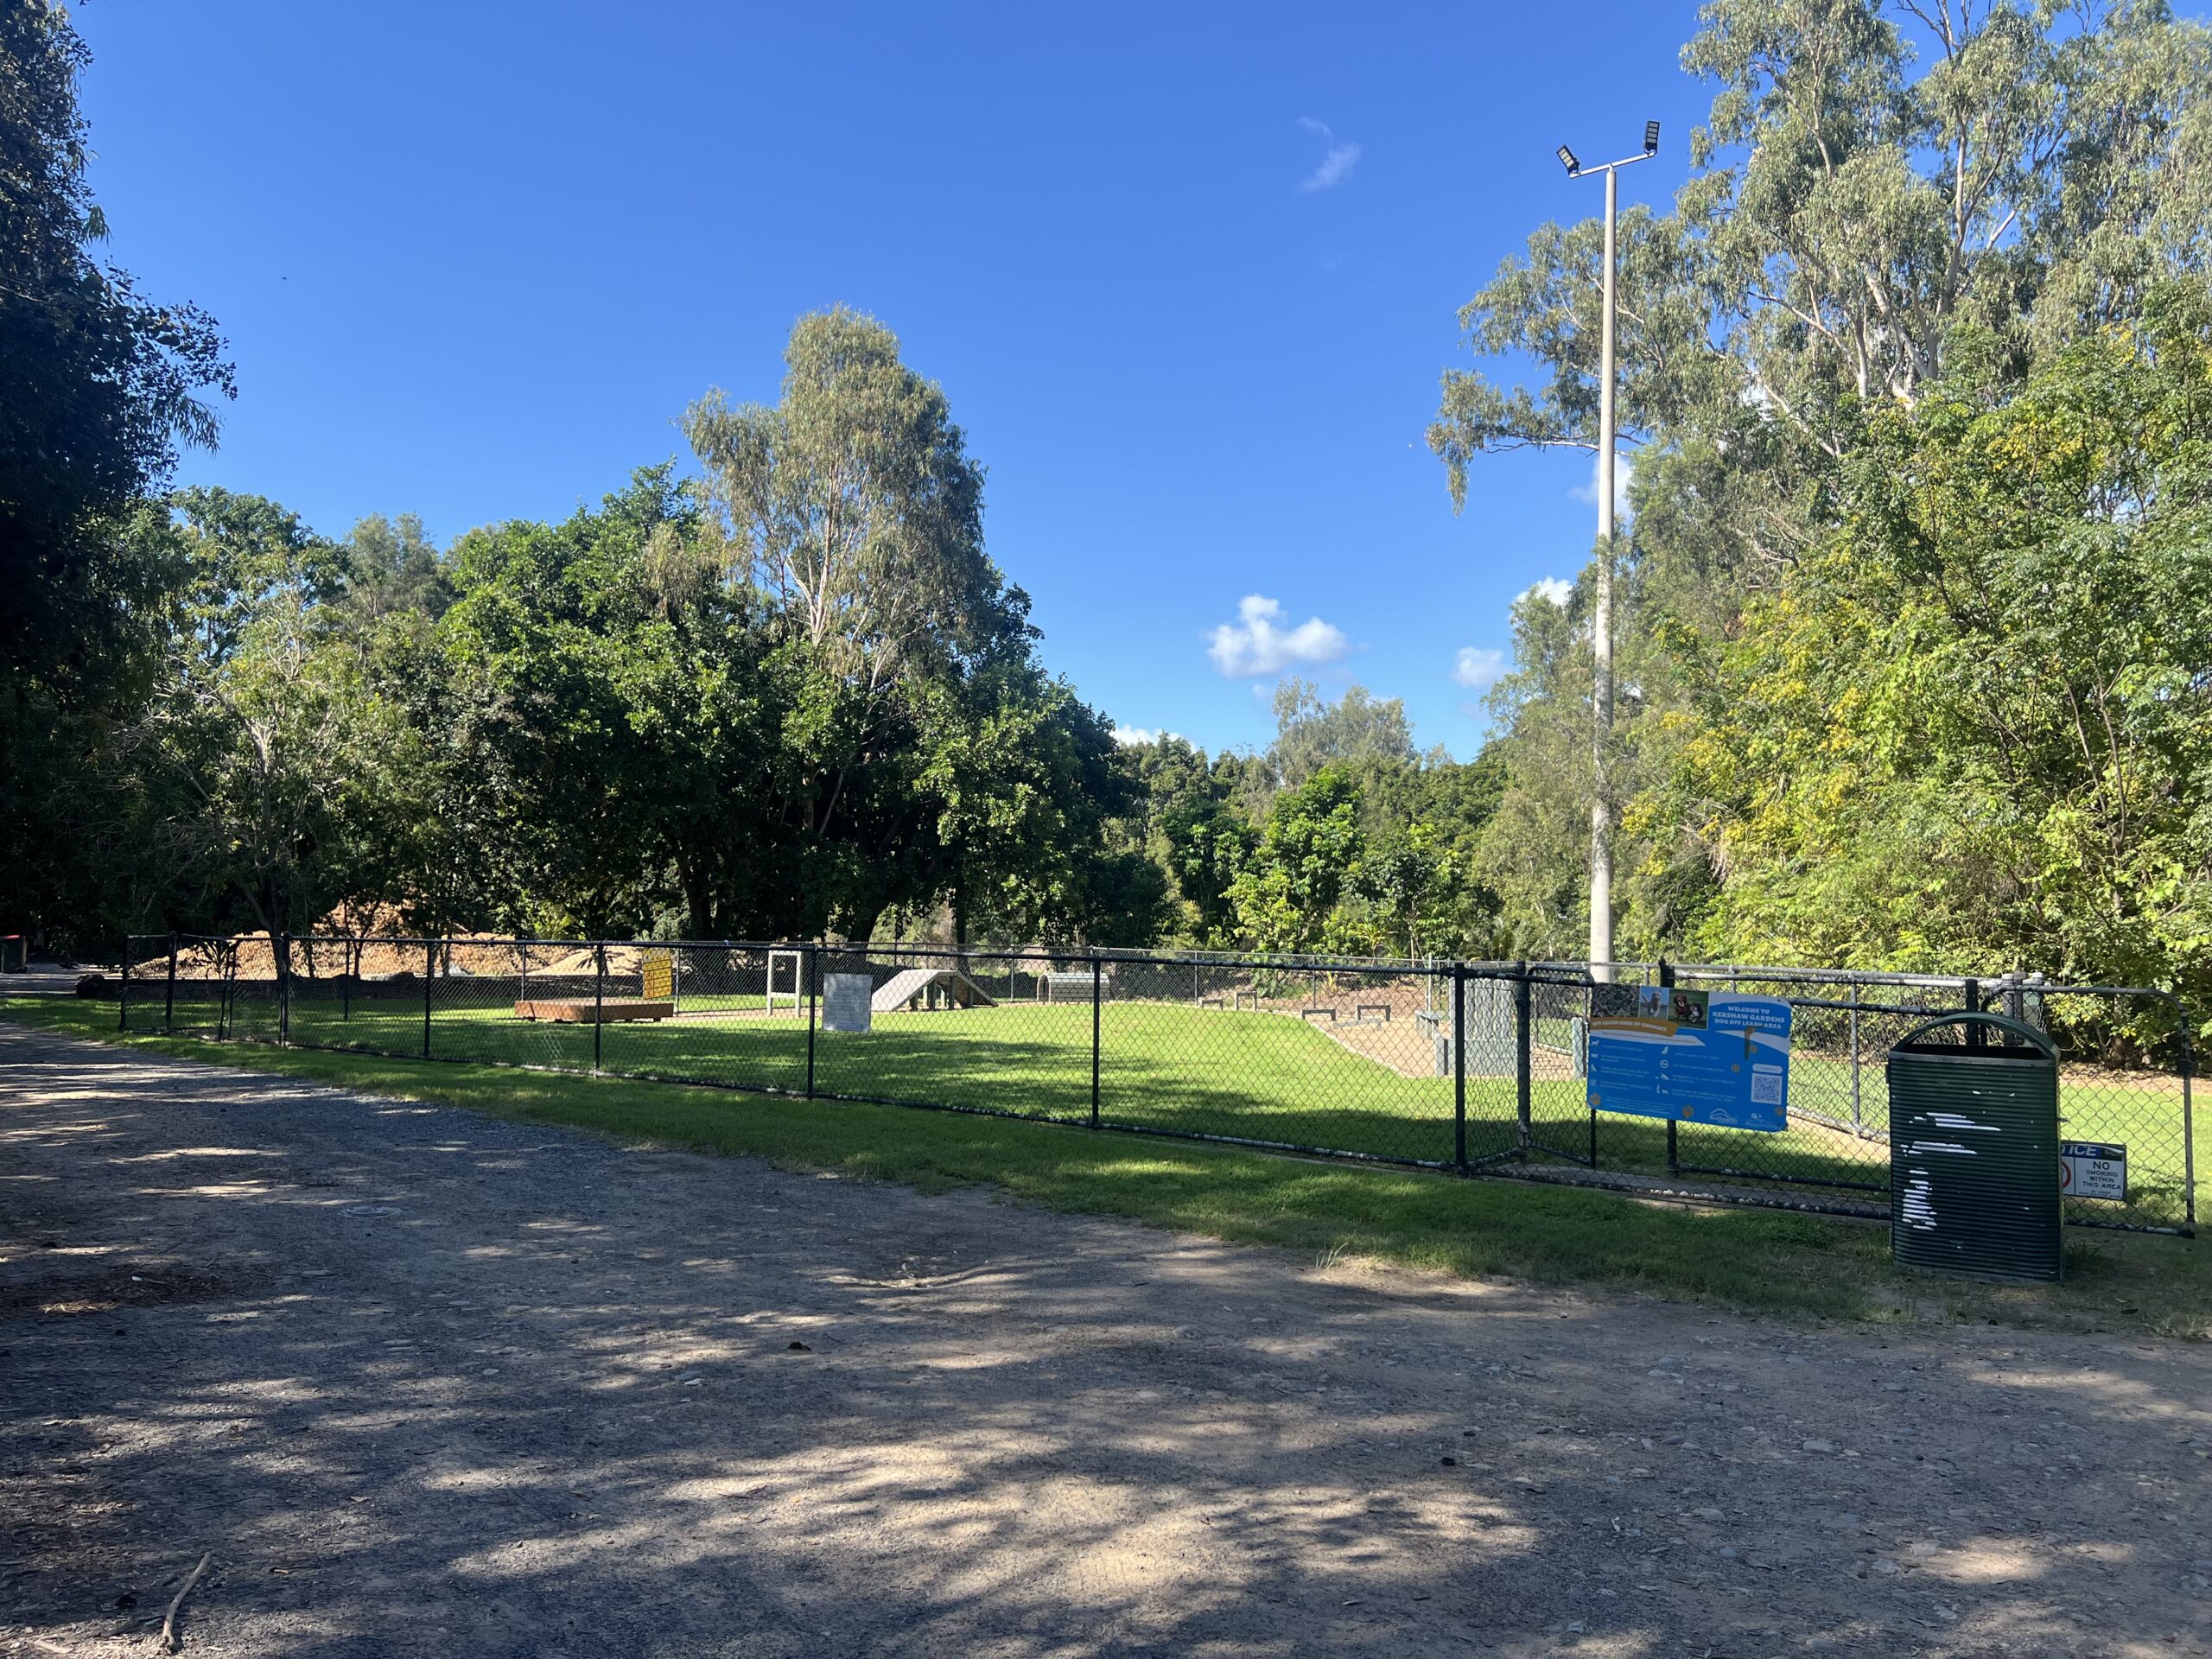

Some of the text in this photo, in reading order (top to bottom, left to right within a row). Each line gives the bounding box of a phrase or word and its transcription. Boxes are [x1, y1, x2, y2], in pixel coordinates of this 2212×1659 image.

[1713, 1011, 1785, 1023] KERSHAW GARDENS
[2061, 1145, 2097, 1156] TICE
[2093, 1160, 2110, 1170] NO
[2086, 1169, 2119, 1178] SMOKING
